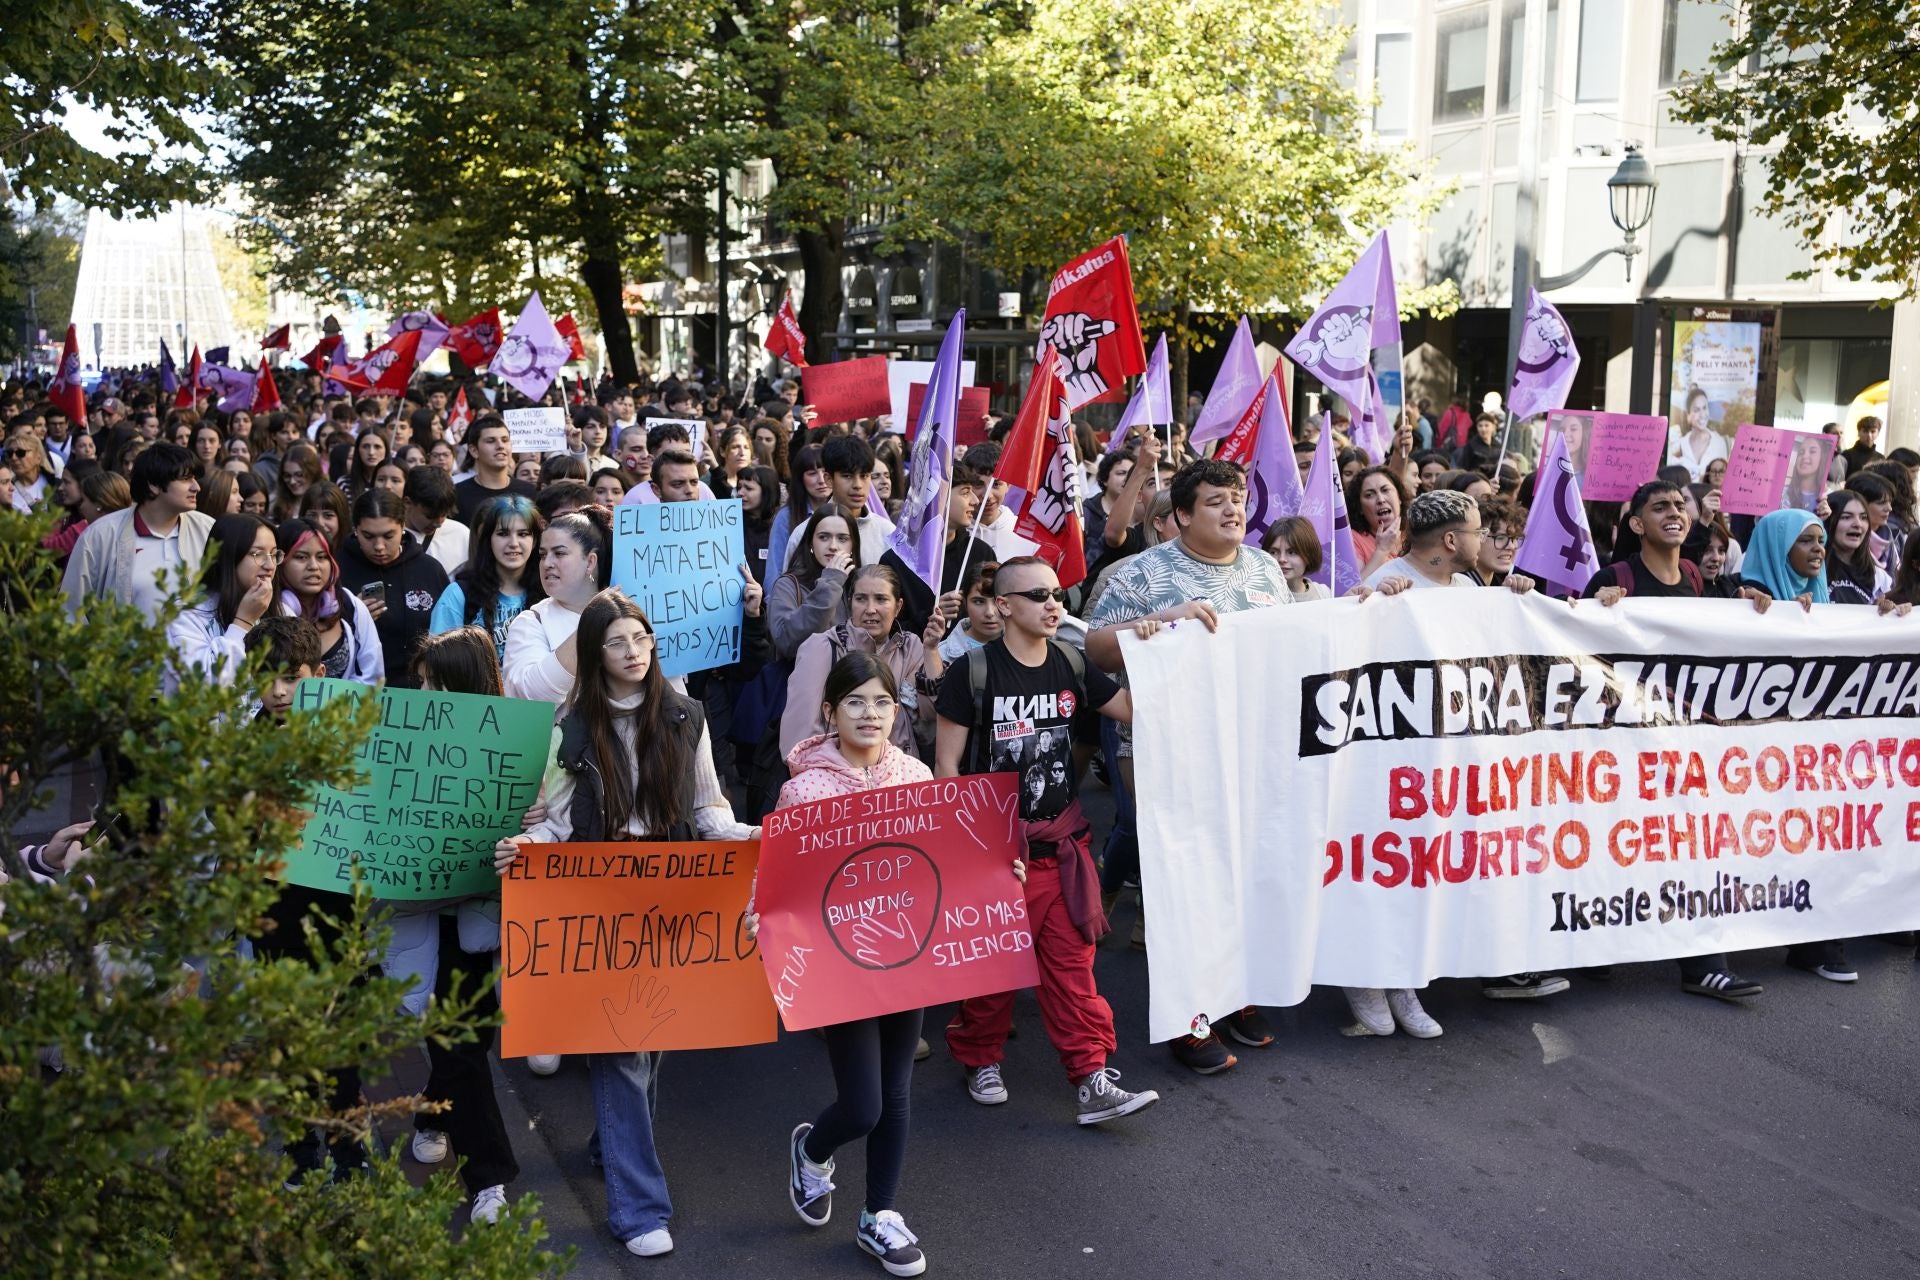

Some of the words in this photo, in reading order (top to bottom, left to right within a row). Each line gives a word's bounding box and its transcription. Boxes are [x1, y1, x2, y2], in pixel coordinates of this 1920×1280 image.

[891, 295, 917, 306] SEPHORA
[1696, 360, 1712, 369] PELI
[1714, 360, 1720, 369] Y
[1721, 360, 1748, 369] MANTA
[620, 508, 645, 537] EL
[633, 543, 694, 580] MATA
[698, 535, 730, 570] EN
[656, 628, 702, 660] EMOS
[478, 704, 501, 736] A
[993, 693, 1059, 721] КИН
[1315, 663, 1529, 746] SANDRA
[1544, 662, 1606, 726] EZ
[1611, 661, 1836, 724] ZAITUGU
[996, 723, 1017, 734] EZKER
[428, 743, 467, 769] NO
[480, 748, 523, 779] TE
[388, 768, 536, 812] FUERTE
[1388, 749, 1621, 821] BULLYING
[1637, 749, 1709, 800] ETA
[314, 793, 380, 825] HACE
[768, 805, 828, 839] BASTA
[831, 798, 853, 822] DE
[861, 782, 959, 817] SILENCIO
[321, 821, 348, 842] AL
[364, 829, 435, 854] ACOSO
[442, 836, 499, 855] ESCO
[797, 812, 943, 855] INSTITUCIONAL
[1608, 802, 1884, 868] GEHIAGORIK
[313, 840, 377, 864] TODOS
[384, 851, 420, 868] LOS
[428, 856, 471, 874] QUE
[509, 853, 537, 881] EL
[547, 853, 660, 880] BULLYING
[665, 850, 737, 878] DUELE
[843, 853, 914, 888] STOP
[828, 892, 915, 927] BULLYING
[944, 902, 980, 930] NO
[986, 897, 1026, 927] MAS
[1550, 887, 1652, 933] Ikasle
[1657, 871, 1814, 924] Sindikatua
[506, 903, 764, 978] DETENGÁMOSLO
[932, 929, 1033, 968] SILENCIO
[773, 943, 815, 1016] ACTÚA
